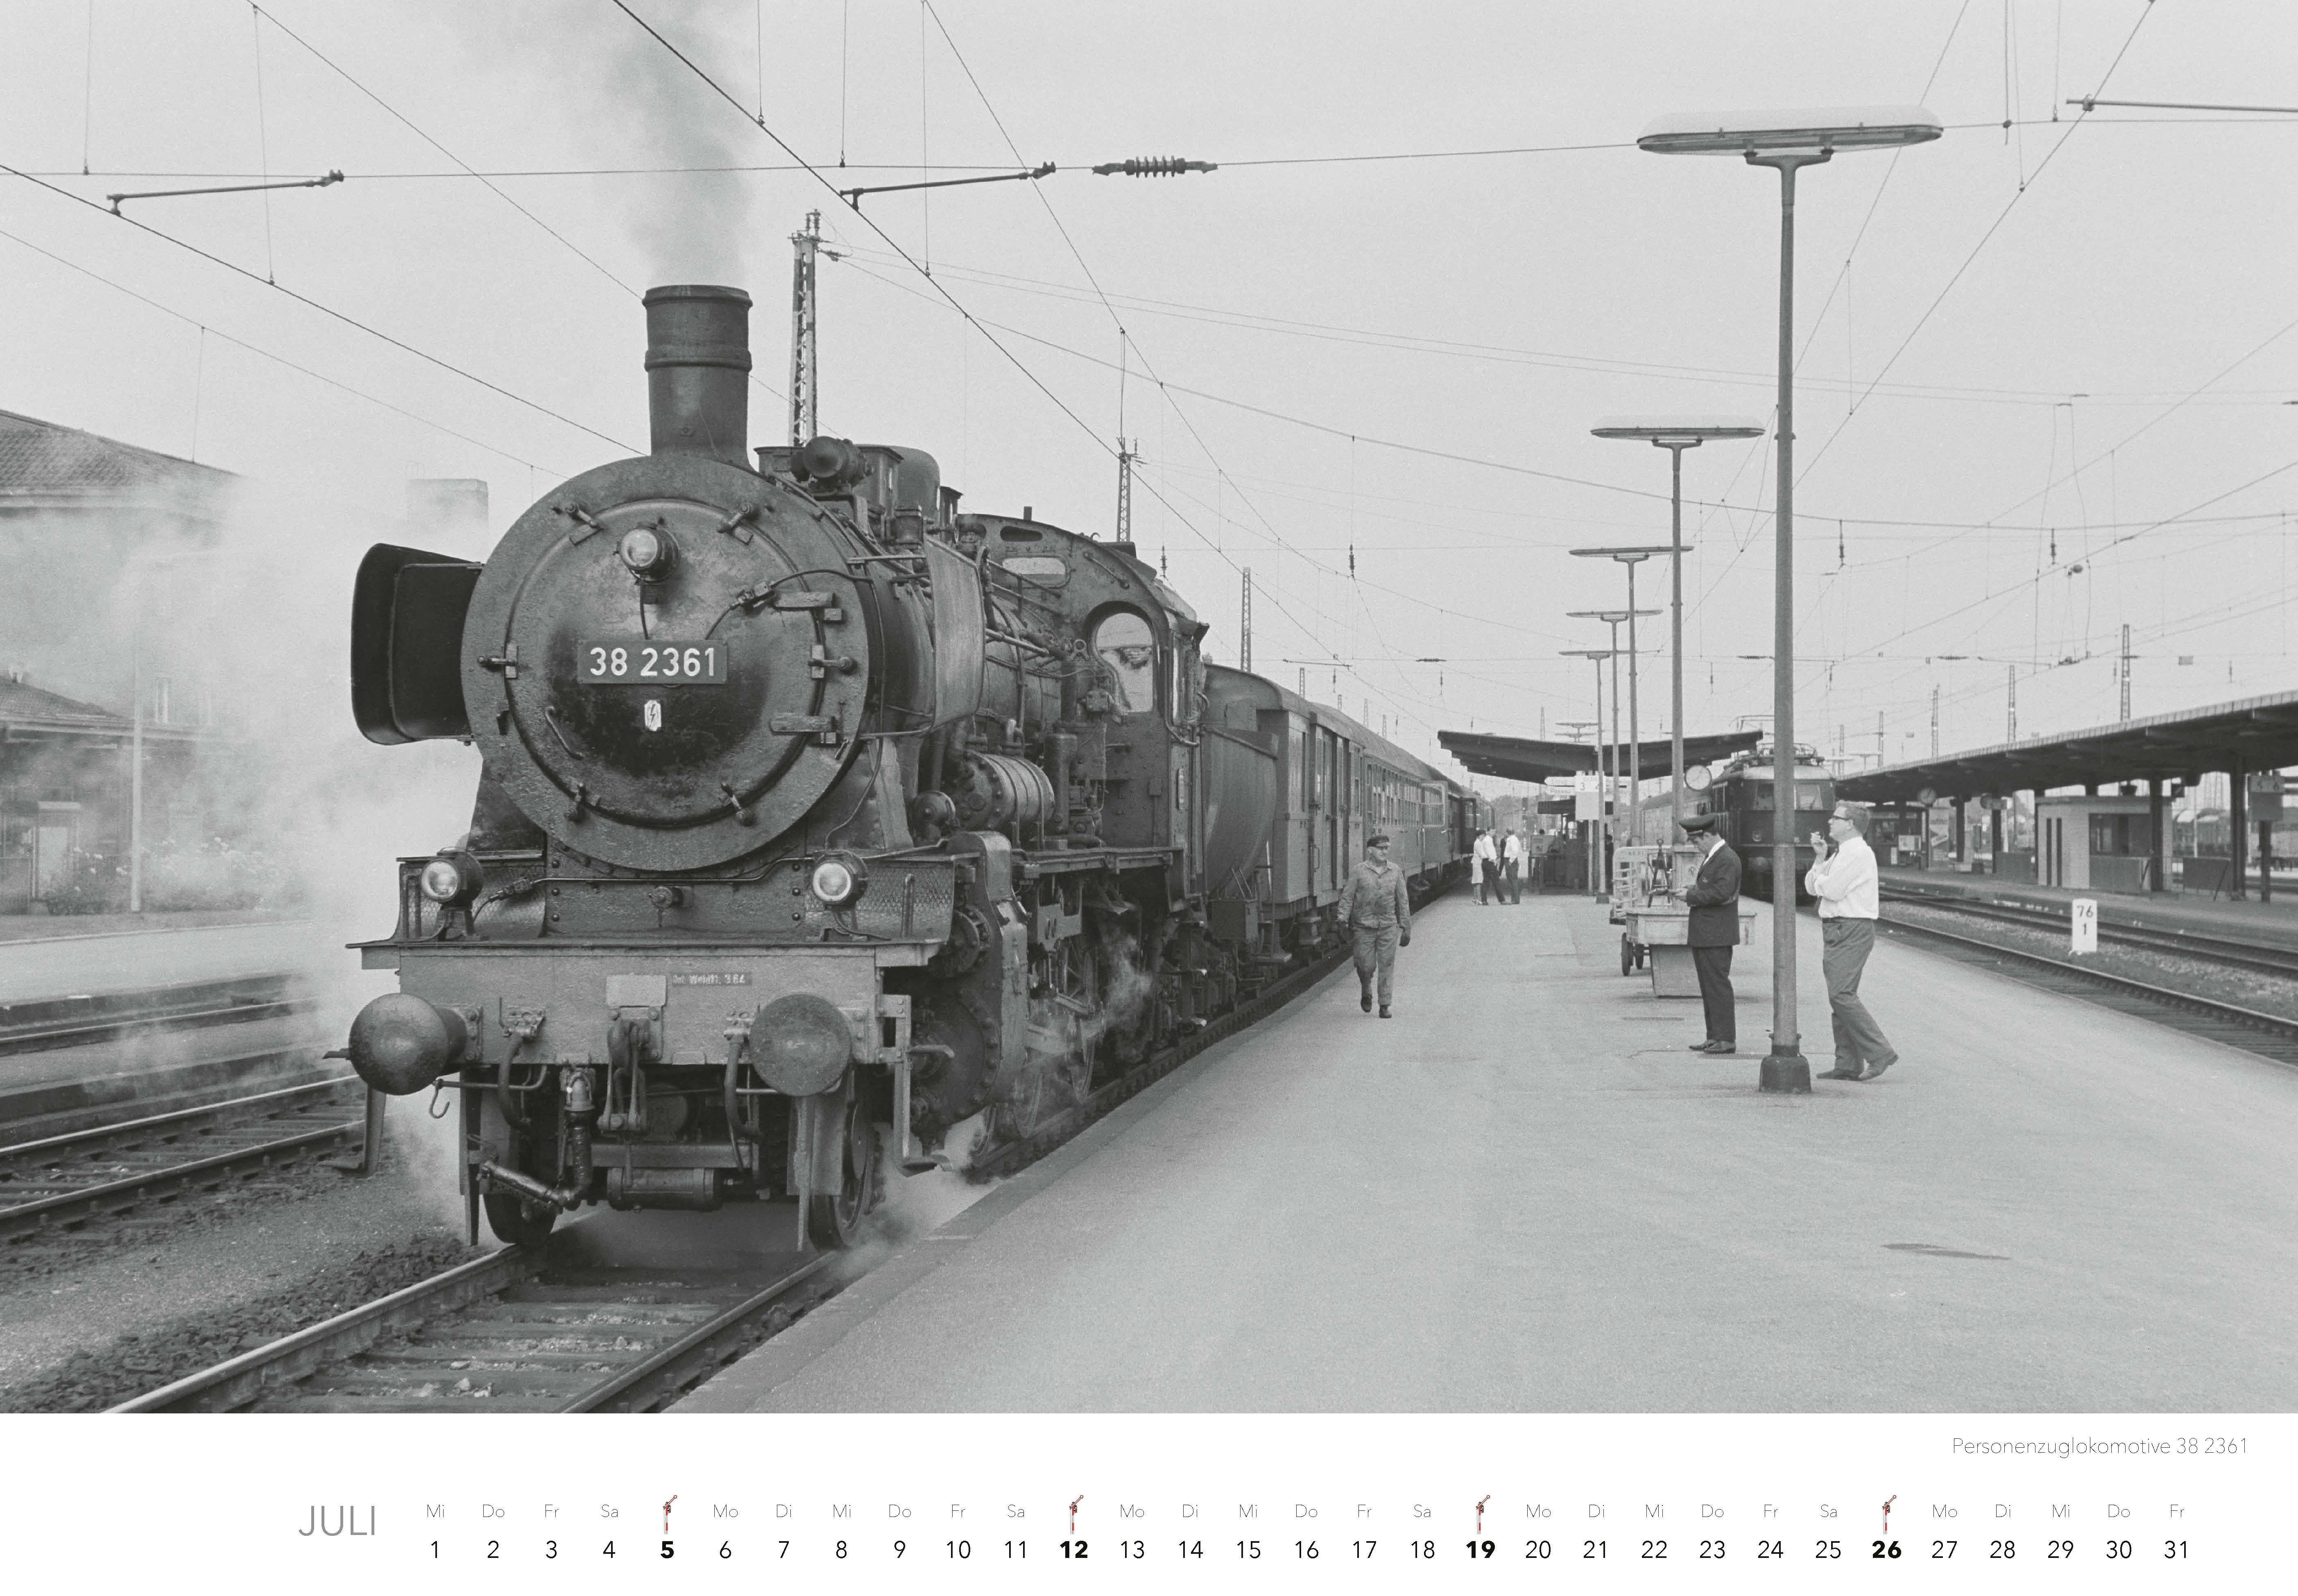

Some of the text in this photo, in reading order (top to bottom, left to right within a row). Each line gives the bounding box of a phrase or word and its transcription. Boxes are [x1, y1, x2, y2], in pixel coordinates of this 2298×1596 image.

[589, 647, 714, 676] 38 2361
[1580, 782, 1585, 791] 3
[2077, 905, 2094, 918] 76
[2083, 922, 2087, 936] 1
